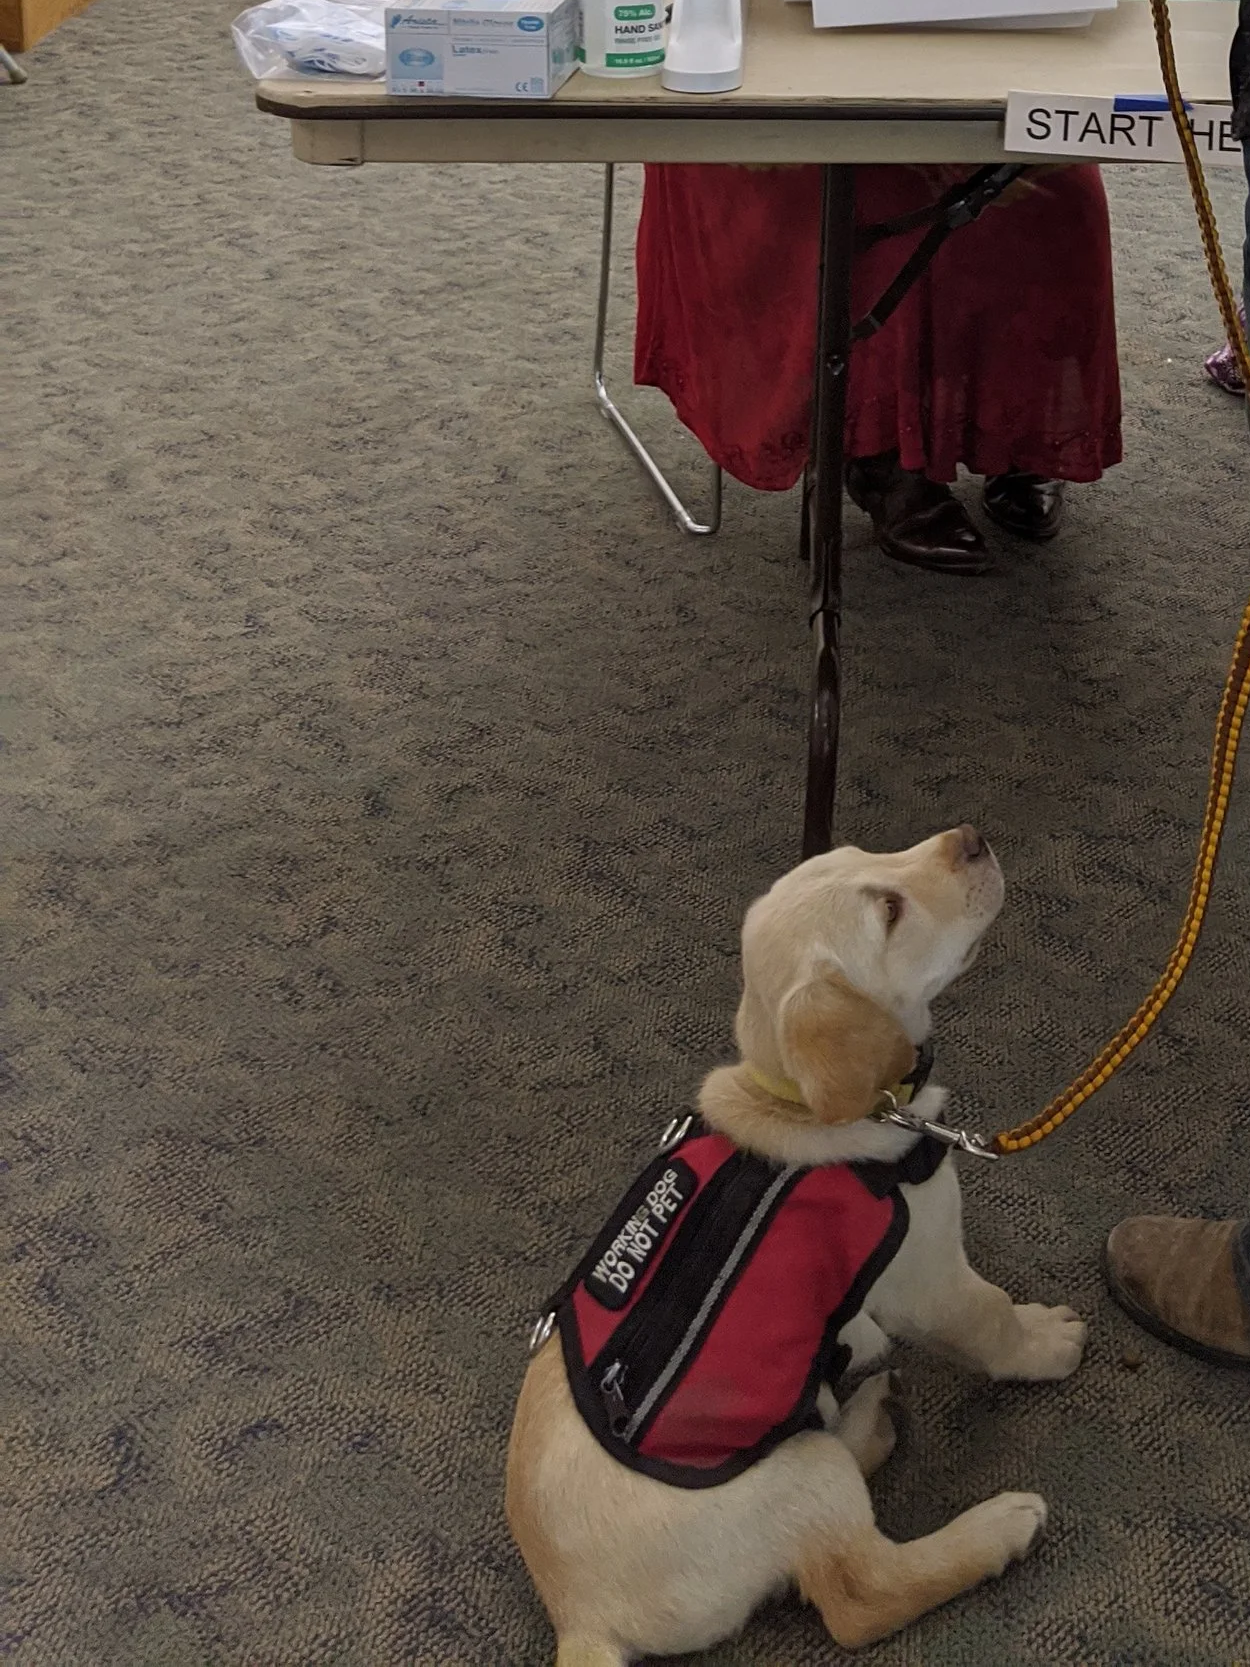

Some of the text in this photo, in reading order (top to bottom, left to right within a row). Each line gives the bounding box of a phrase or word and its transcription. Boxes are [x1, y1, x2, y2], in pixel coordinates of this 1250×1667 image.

[614, 24, 646, 35] HAND
[1026, 107, 1164, 148] START
[592, 1169, 679, 1283] WORKING DOG
[608, 1182, 684, 1294] DO NOT PET
